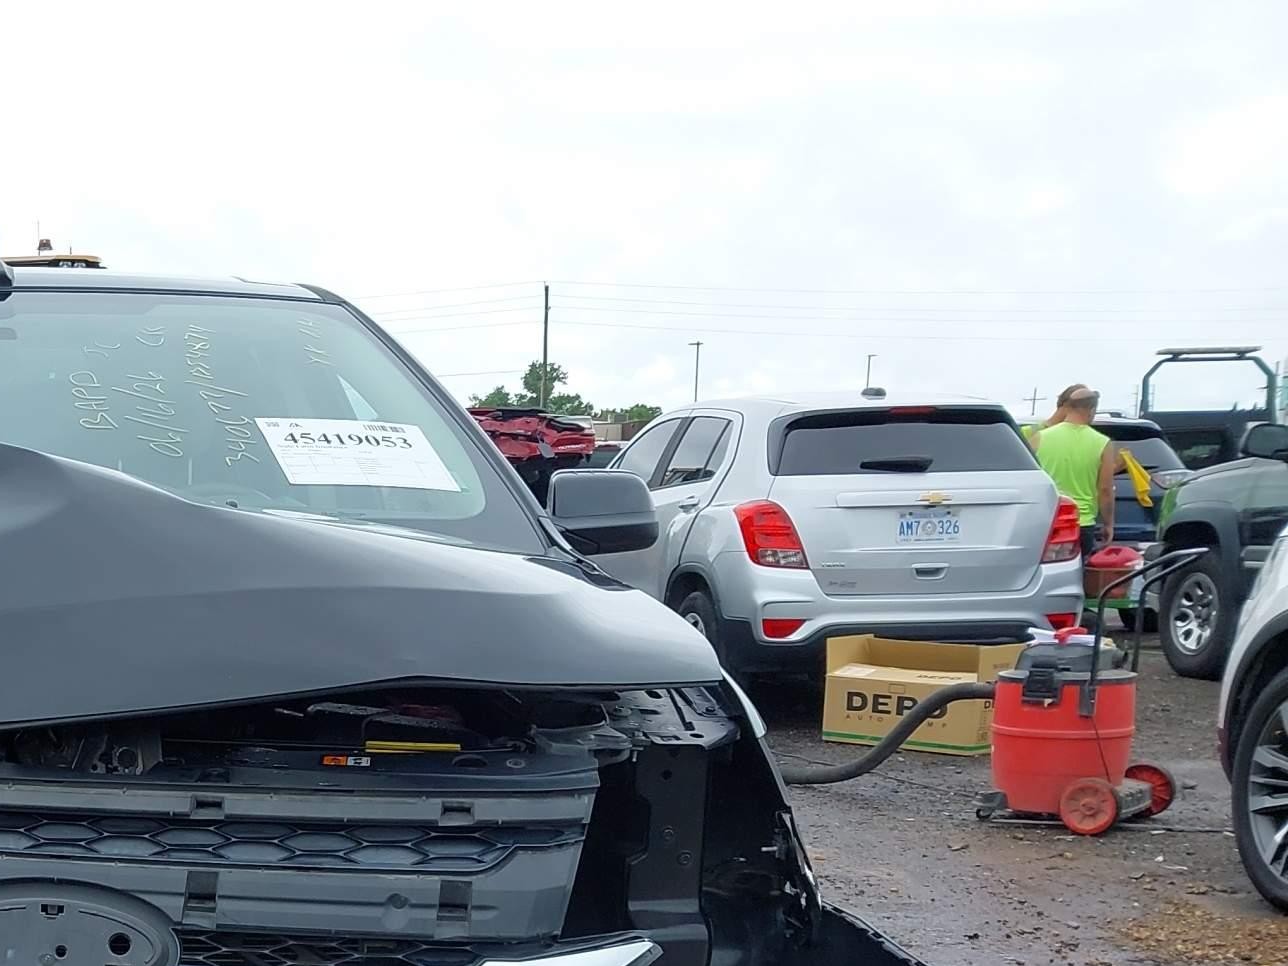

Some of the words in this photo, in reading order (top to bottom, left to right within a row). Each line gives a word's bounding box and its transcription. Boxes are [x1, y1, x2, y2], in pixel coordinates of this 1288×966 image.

[69, 370, 118, 429] BAPD
[111, 371, 190, 457] 06/16/26
[283, 432, 413, 450] 45419053
[898, 520, 920, 537] AM7
[937, 519, 960, 535] 326
